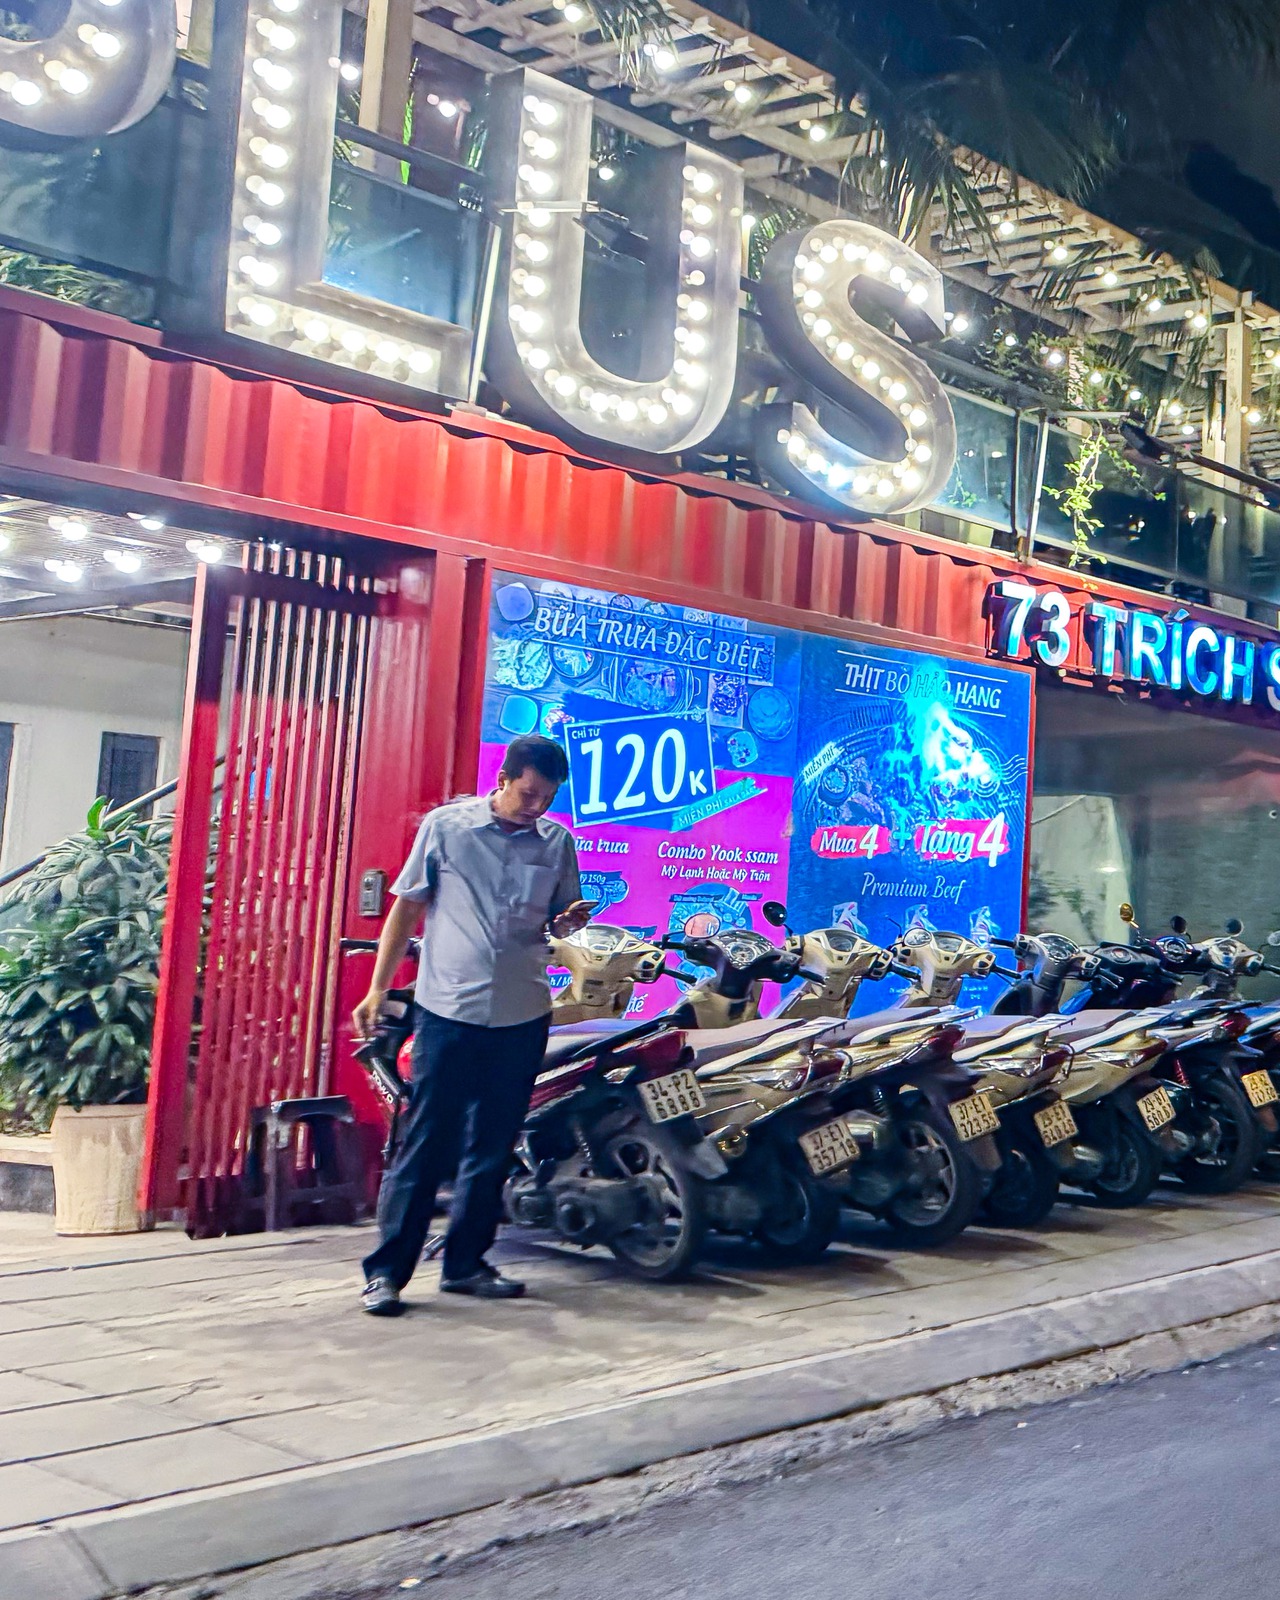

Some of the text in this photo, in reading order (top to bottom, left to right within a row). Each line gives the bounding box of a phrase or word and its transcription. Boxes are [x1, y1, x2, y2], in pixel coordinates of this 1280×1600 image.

[534, 606, 765, 671] BỮA TRƯA ĐẶC BIỆT
[1001, 580, 1070, 667] 73
[1088, 602, 1256, 706] TRÍCH
[845, 663, 885, 692] THỊT
[954, 681, 1002, 709] HẠNG
[657, 841, 779, 865] Combo Yook ssam
[819, 830, 858, 854] Mua
[859, 824, 880, 860] 4
[920, 820, 975, 862] Tặng
[977, 812, 1006, 868] 4
[861, 872, 967, 905] Premium Beef
